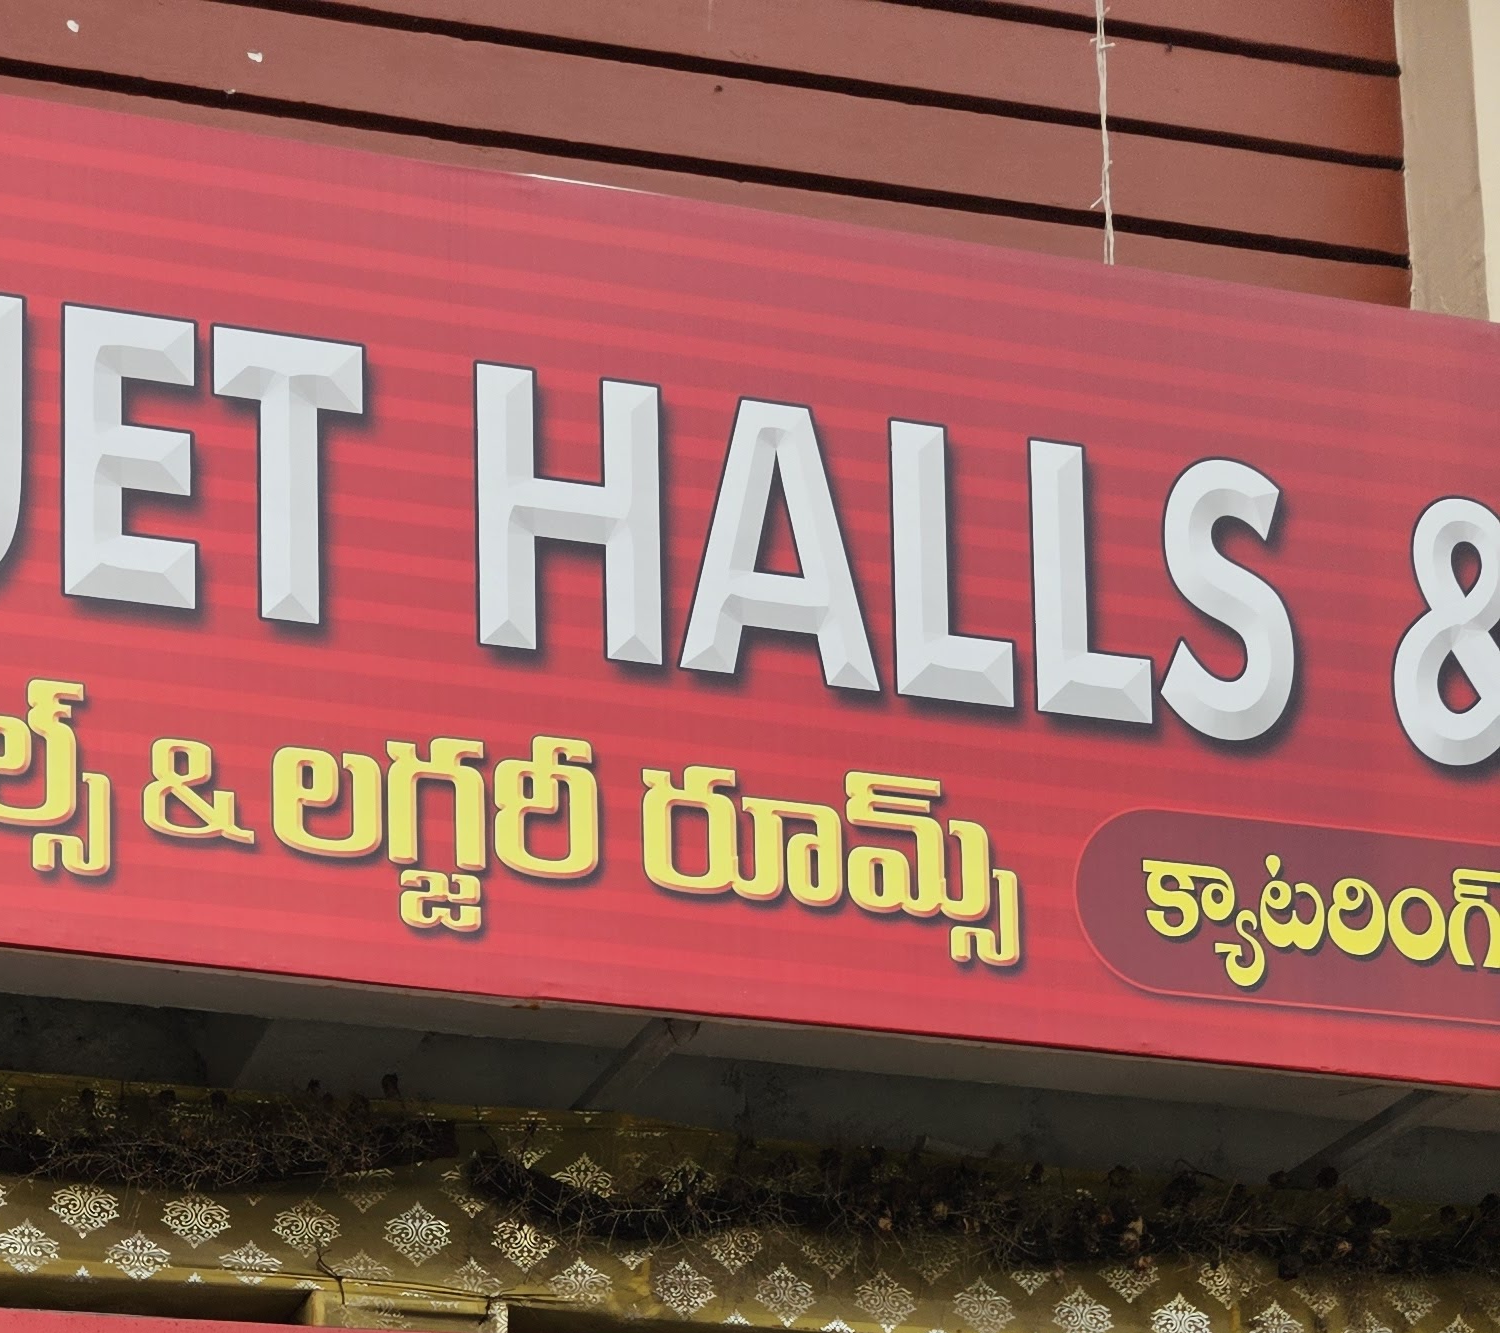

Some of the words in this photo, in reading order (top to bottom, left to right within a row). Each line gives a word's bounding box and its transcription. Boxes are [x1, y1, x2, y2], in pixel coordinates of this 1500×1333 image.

[473, 361, 1296, 741] HALLS
[1393, 496, 1500, 767] &
[142, 738, 256, 845] &
[271, 735, 600, 932] లగ్జరీ
[640, 764, 1022, 967] రూమ్స్
